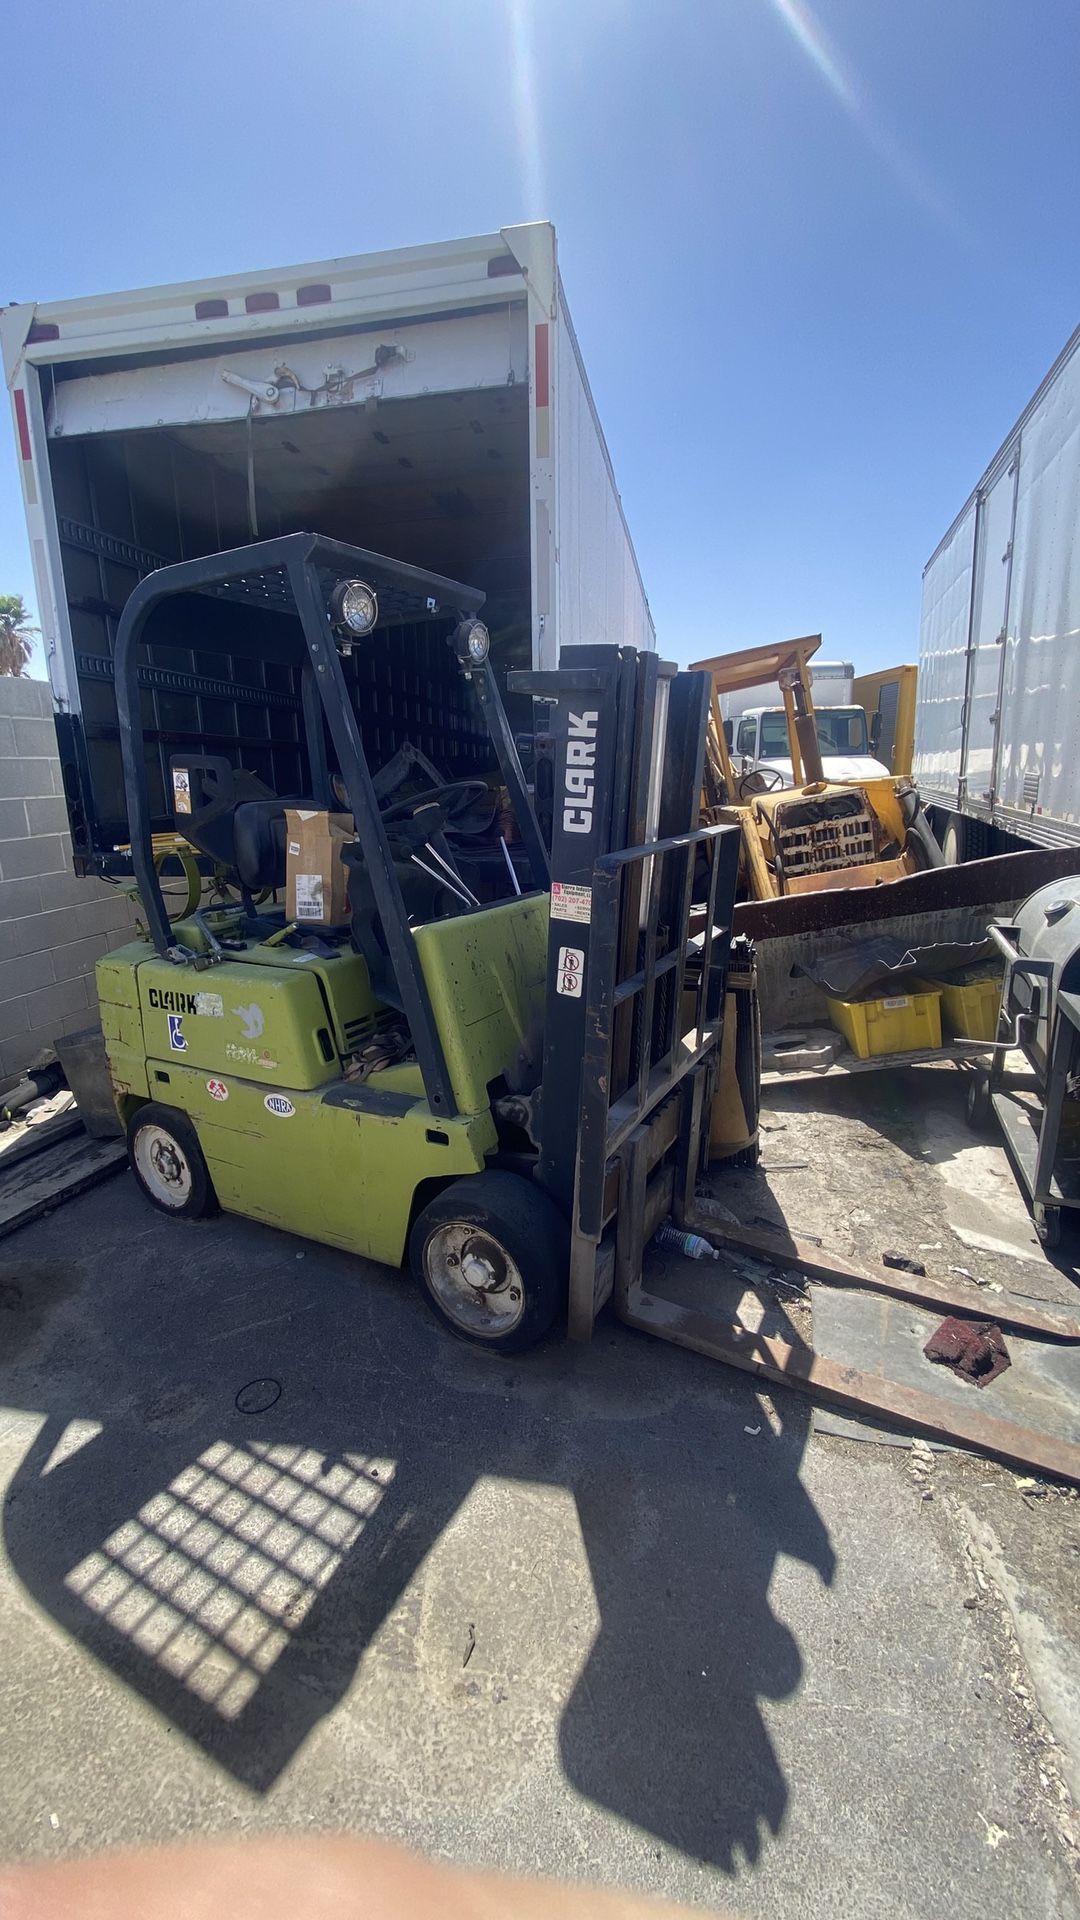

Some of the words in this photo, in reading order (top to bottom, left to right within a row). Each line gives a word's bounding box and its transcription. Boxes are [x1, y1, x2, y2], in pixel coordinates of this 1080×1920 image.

[563, 711, 599, 834] CLARK
[552, 895, 568, 903] (702)
[149, 988, 198, 1015] CLARK
[269, 1098, 292, 1113] NHRA
